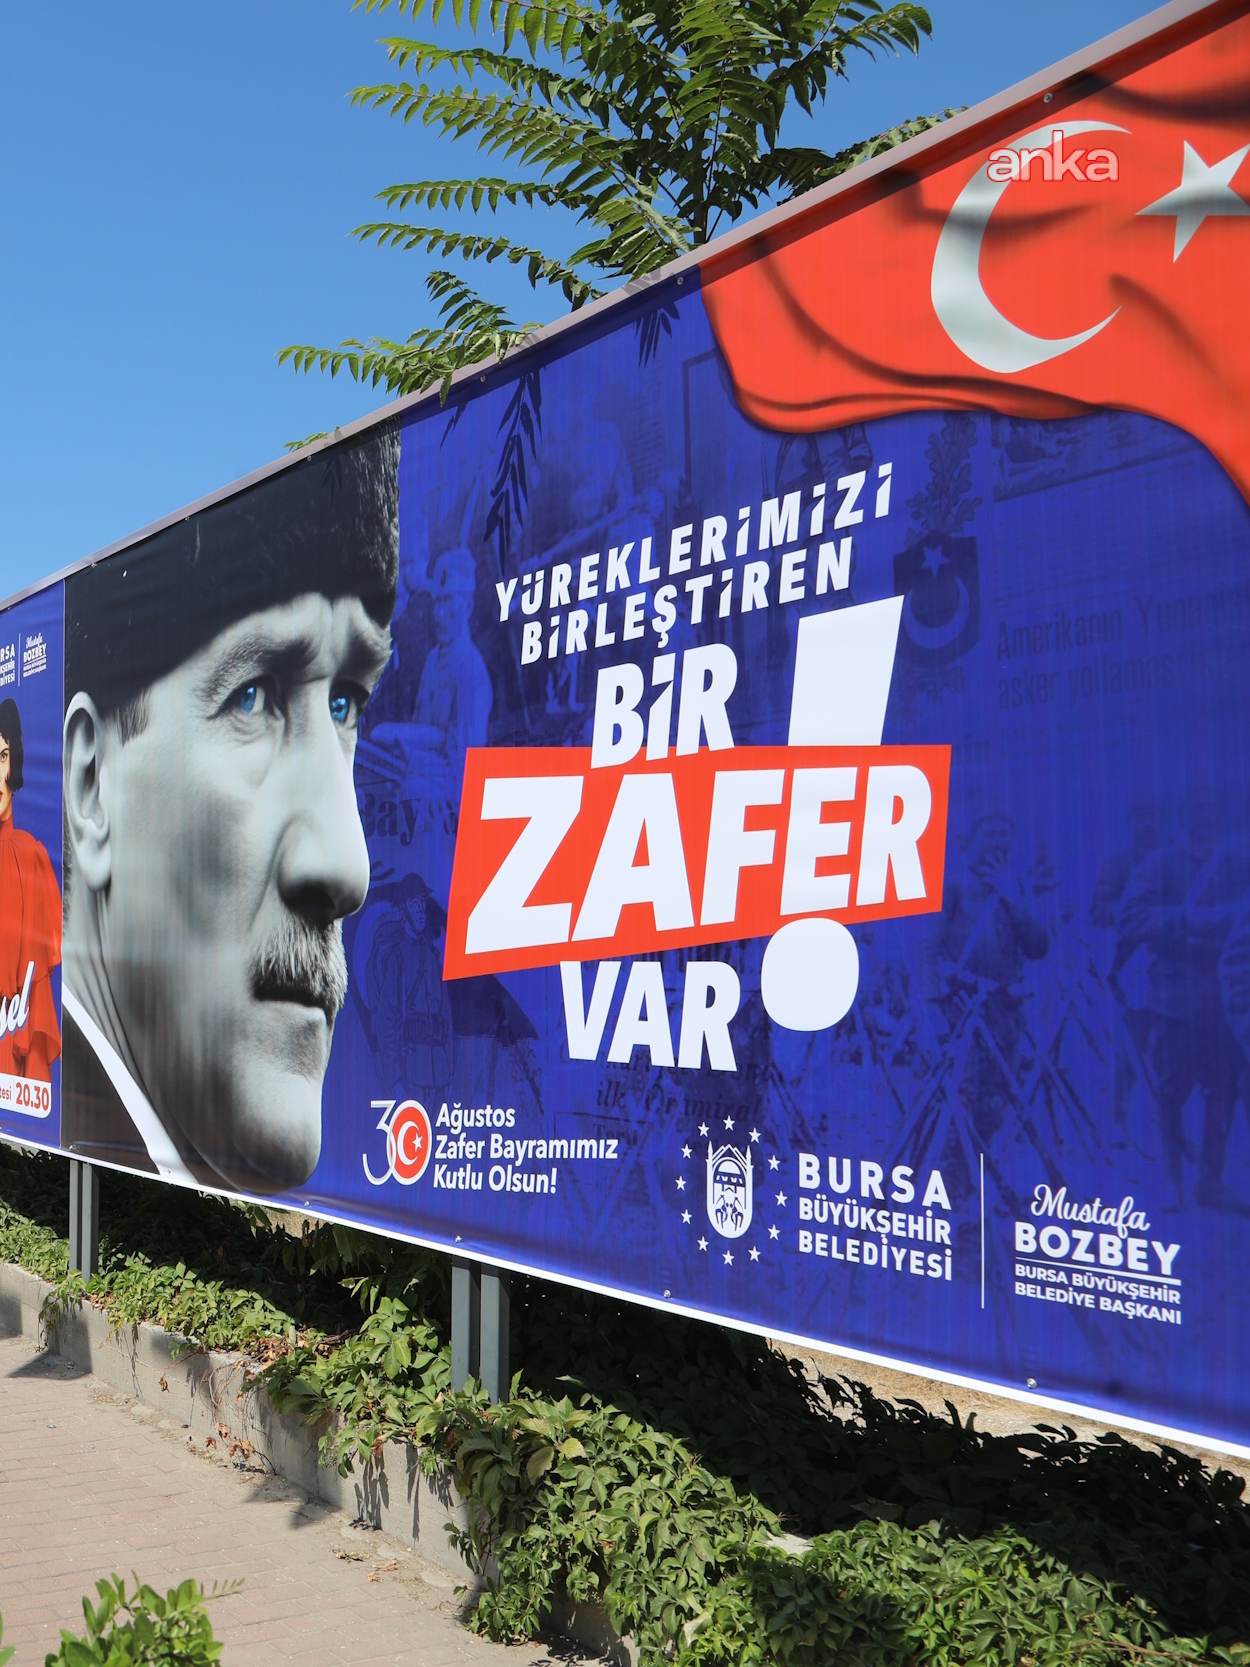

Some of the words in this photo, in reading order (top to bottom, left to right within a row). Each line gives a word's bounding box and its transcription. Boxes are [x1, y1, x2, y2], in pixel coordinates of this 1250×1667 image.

[23, 643, 46, 663] BOZBEY
[465, 765, 932, 955] ZAFER
[15, 1082, 50, 1111] 20.30
[363, 1100, 432, 1185] 30
[435, 1102, 516, 1135] Ağustos
[435, 1133, 485, 1159] Zafer
[490, 1133, 618, 1166] Bayramımız
[433, 1164, 483, 1190] Kutlu
[488, 1165, 557, 1194] Olsun!
[798, 1152, 952, 1211] BURSA
[798, 1194, 952, 1245] BÜYÜKŞEHİR
[1030, 1184, 1151, 1239] Mustafa
[798, 1229, 952, 1281] BELEDİYESİ
[1014, 1221, 1181, 1276] BOZBEY
[1014, 1263, 1069, 1285] BURSA
[1071, 1272, 1181, 1304] BÜYÜKŞEHİR
[1014, 1281, 1095, 1309] BELEDİYE
[1099, 1297, 1182, 1324] BAŞKANI
